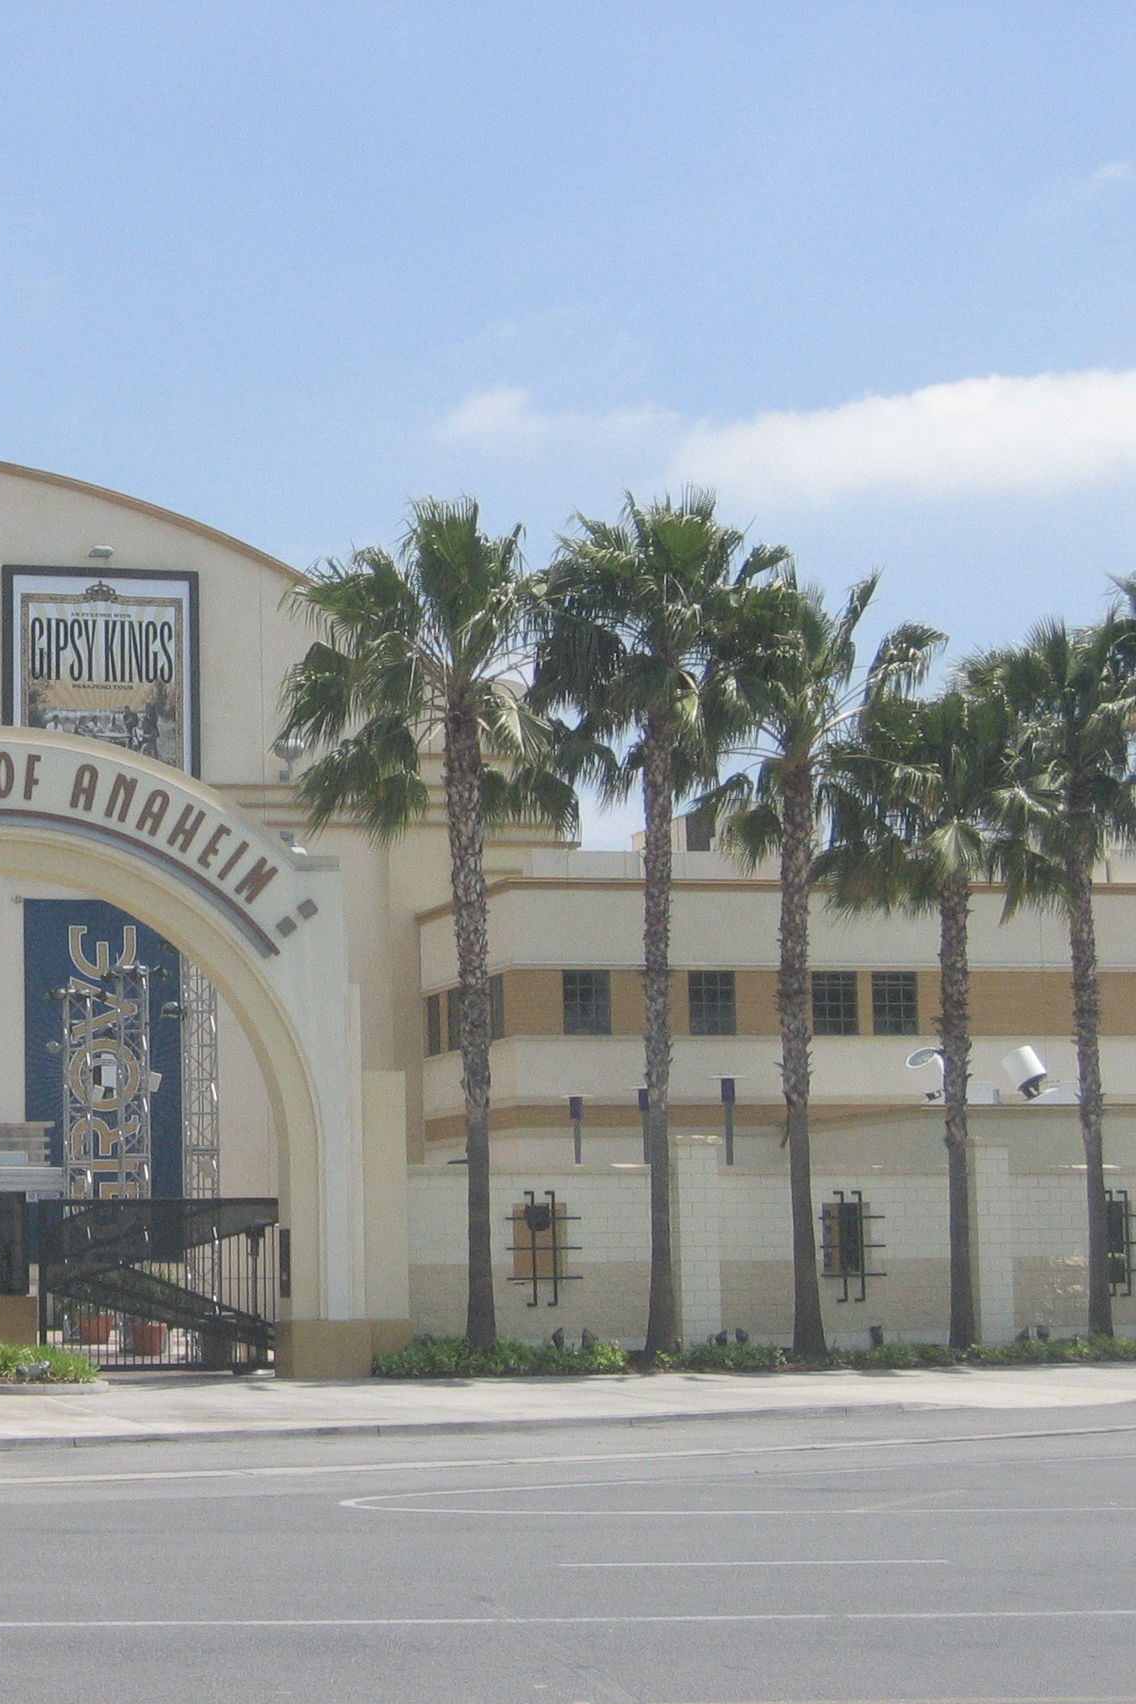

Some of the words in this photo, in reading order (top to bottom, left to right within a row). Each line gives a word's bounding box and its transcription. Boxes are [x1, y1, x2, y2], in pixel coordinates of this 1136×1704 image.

[31, 617, 97, 682] GIPSY
[104, 620, 173, 683] KINGS
[69, 763, 279, 906] ANAHEIM
